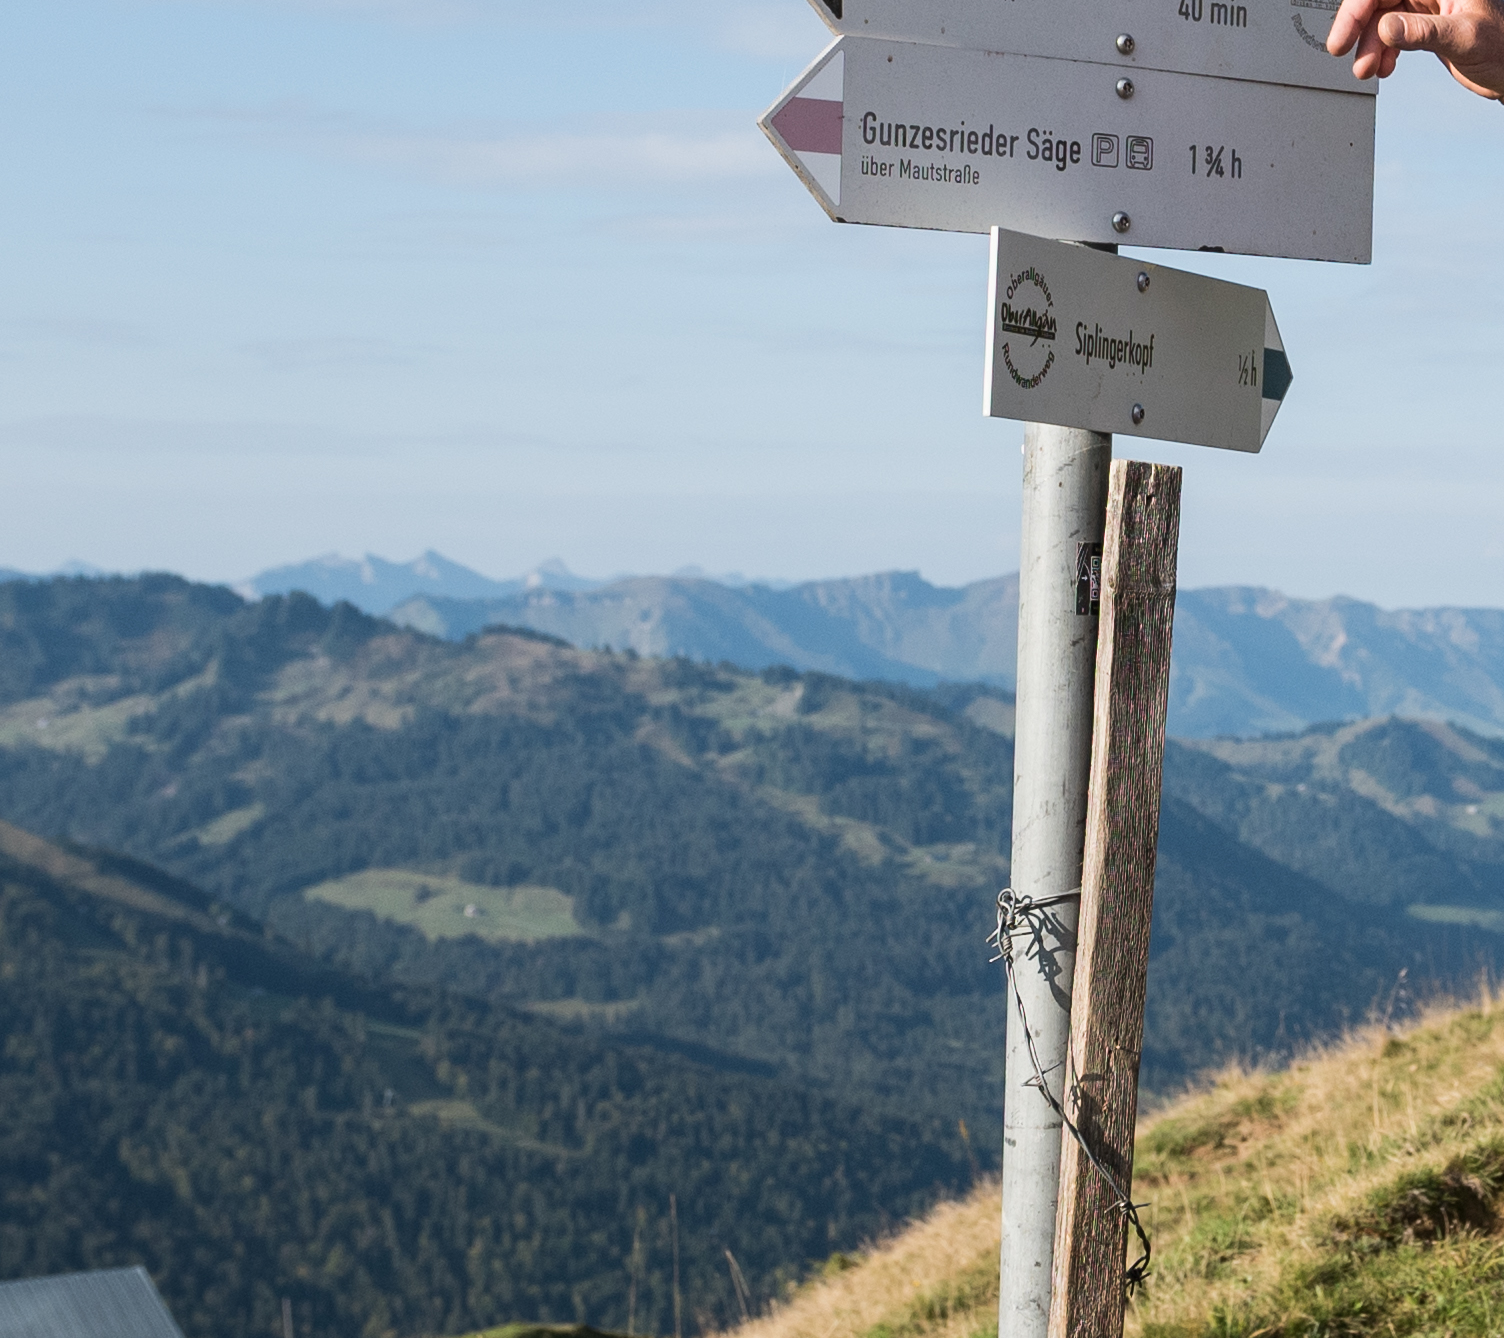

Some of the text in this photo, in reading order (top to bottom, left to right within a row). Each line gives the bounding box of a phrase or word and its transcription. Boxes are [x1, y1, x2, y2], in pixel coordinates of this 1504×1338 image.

[860, 110, 1019, 160] Gunzesrieder
[1026, 128, 1082, 172] Säge
[1188, 145, 1197, 175] 1
[1230, 149, 1243, 180] h
[860, 156, 981, 186] über Mautstraße
[1006, 266, 1054, 308] Oberallgäuer
[1001, 341, 1056, 390] Rundwanderweg
[1074, 321, 1155, 376] Siplingerkopf
[1250, 351, 1257, 388] h
